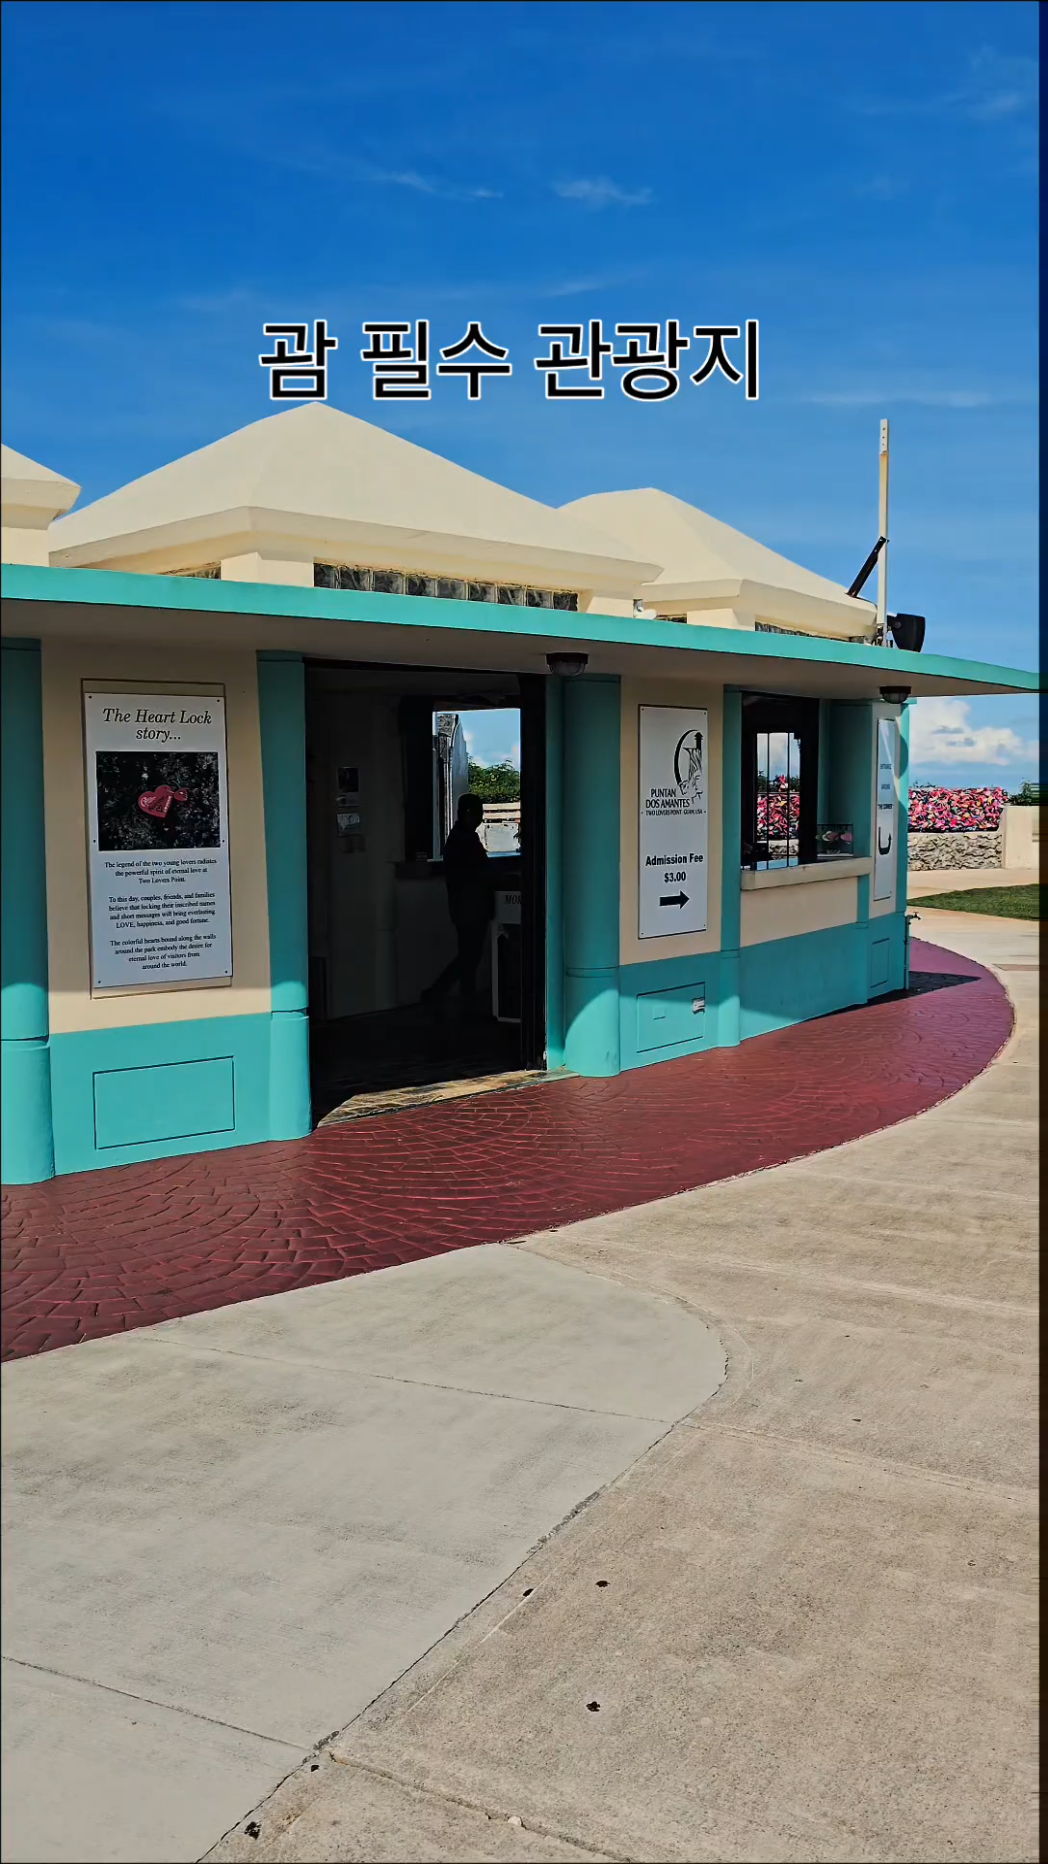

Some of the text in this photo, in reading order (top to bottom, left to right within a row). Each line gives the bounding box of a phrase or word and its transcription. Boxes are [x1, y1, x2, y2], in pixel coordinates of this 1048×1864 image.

[103, 708, 212, 724] The Heart Lock
[136, 728, 180, 742] story...
[651, 788, 676, 797] PUNTAN
[646, 799, 690, 808] DOS AMANTES
[645, 853, 703, 866] Admission Fee
[664, 872, 686, 883] $3.00
